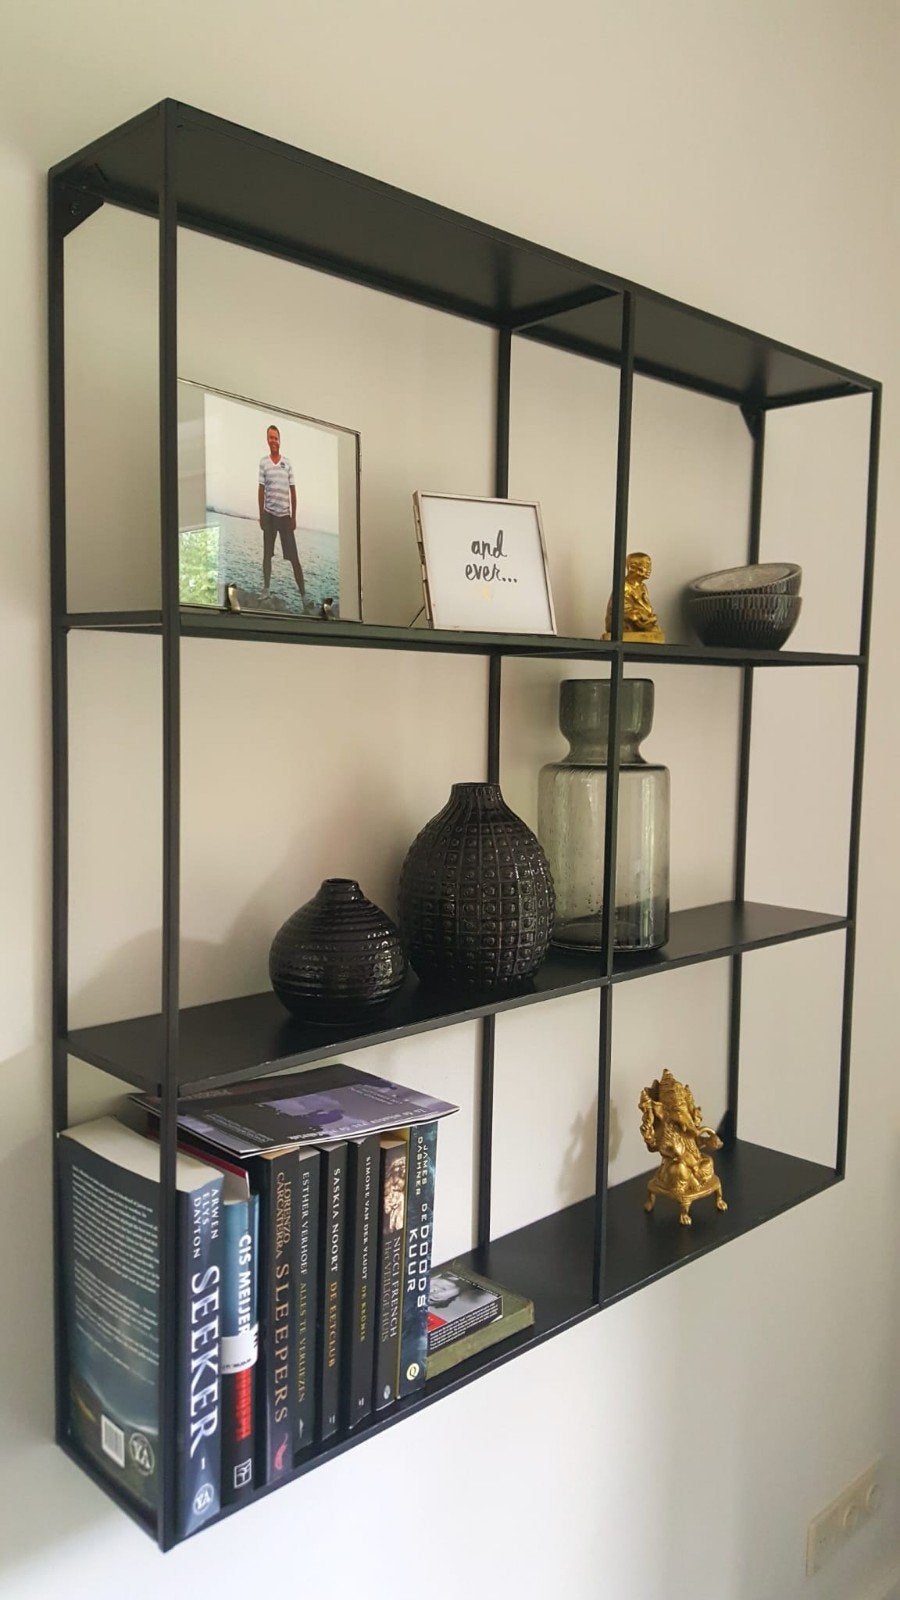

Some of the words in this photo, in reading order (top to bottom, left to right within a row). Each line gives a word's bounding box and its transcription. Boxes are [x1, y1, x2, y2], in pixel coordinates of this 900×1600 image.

[471, 529, 508, 560] and
[415, 1136, 423, 1196] DASHNER
[421, 1144, 429, 1185] JAMES
[202, 1192, 211, 1226] ELYS
[210, 1188, 219, 1240] ARWEN
[275, 1171, 286, 1260] CARCATERRA
[283, 1181, 292, 1244] LORENZO
[302, 1171, 310, 1220] ESTHER
[332, 1168, 341, 1220] SASKIA
[421, 1202, 428, 1222] DE
[193, 1196, 202, 1259] DAYTON
[238, 1234, 252, 1267] CIS
[300, 1221, 309, 1275] VERHOEF
[330, 1223, 340, 1272] NOORT
[391, 1236, 401, 1277] NICCI
[407, 1228, 419, 1293] KUUR
[417, 1224, 430, 1308] DOODS
[330, 1281, 337, 1301] DE
[389, 1280, 400, 1338] FRENCH
[190, 1265, 220, 1458] SEEKER
[274, 1264, 290, 1424] SLEEPERS
